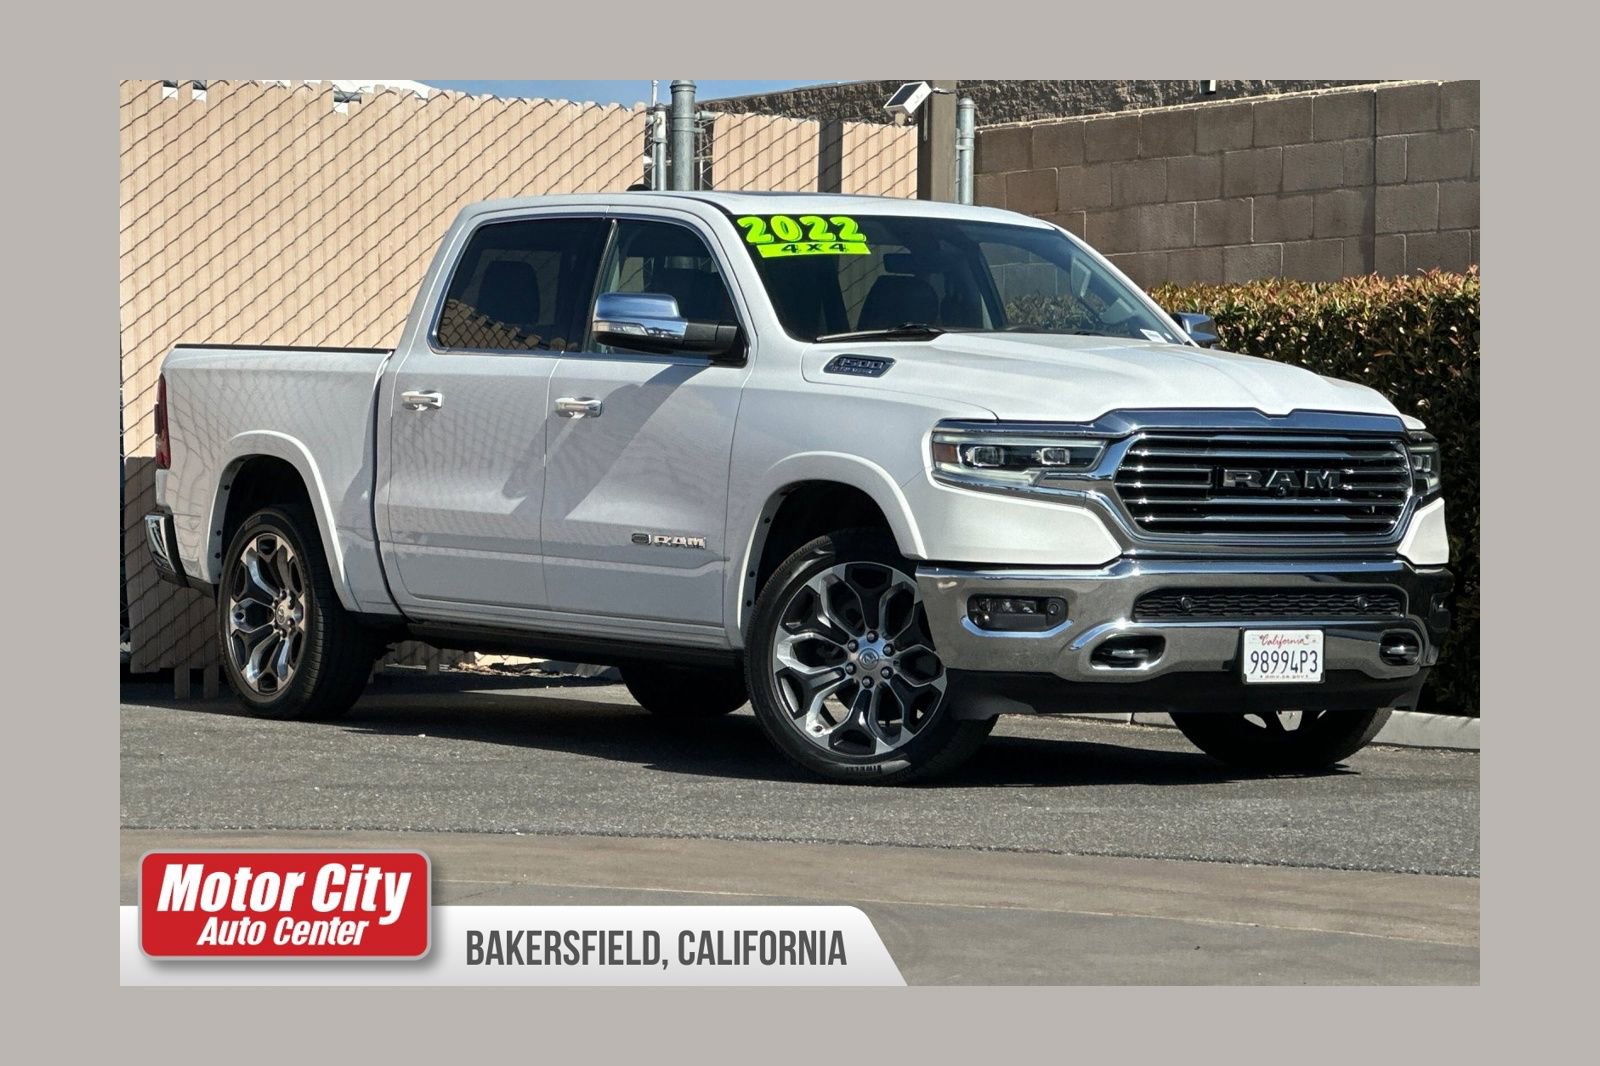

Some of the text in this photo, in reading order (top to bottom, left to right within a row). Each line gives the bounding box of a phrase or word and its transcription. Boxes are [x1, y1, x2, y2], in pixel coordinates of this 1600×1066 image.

[737, 215, 867, 243] 2022
[838, 358, 884, 369] 1500
[1223, 469, 1341, 489] RAM
[654, 535, 706, 549] RAM
[1260, 634, 1309, 648] California
[1250, 650, 1318, 674] 98994P3
